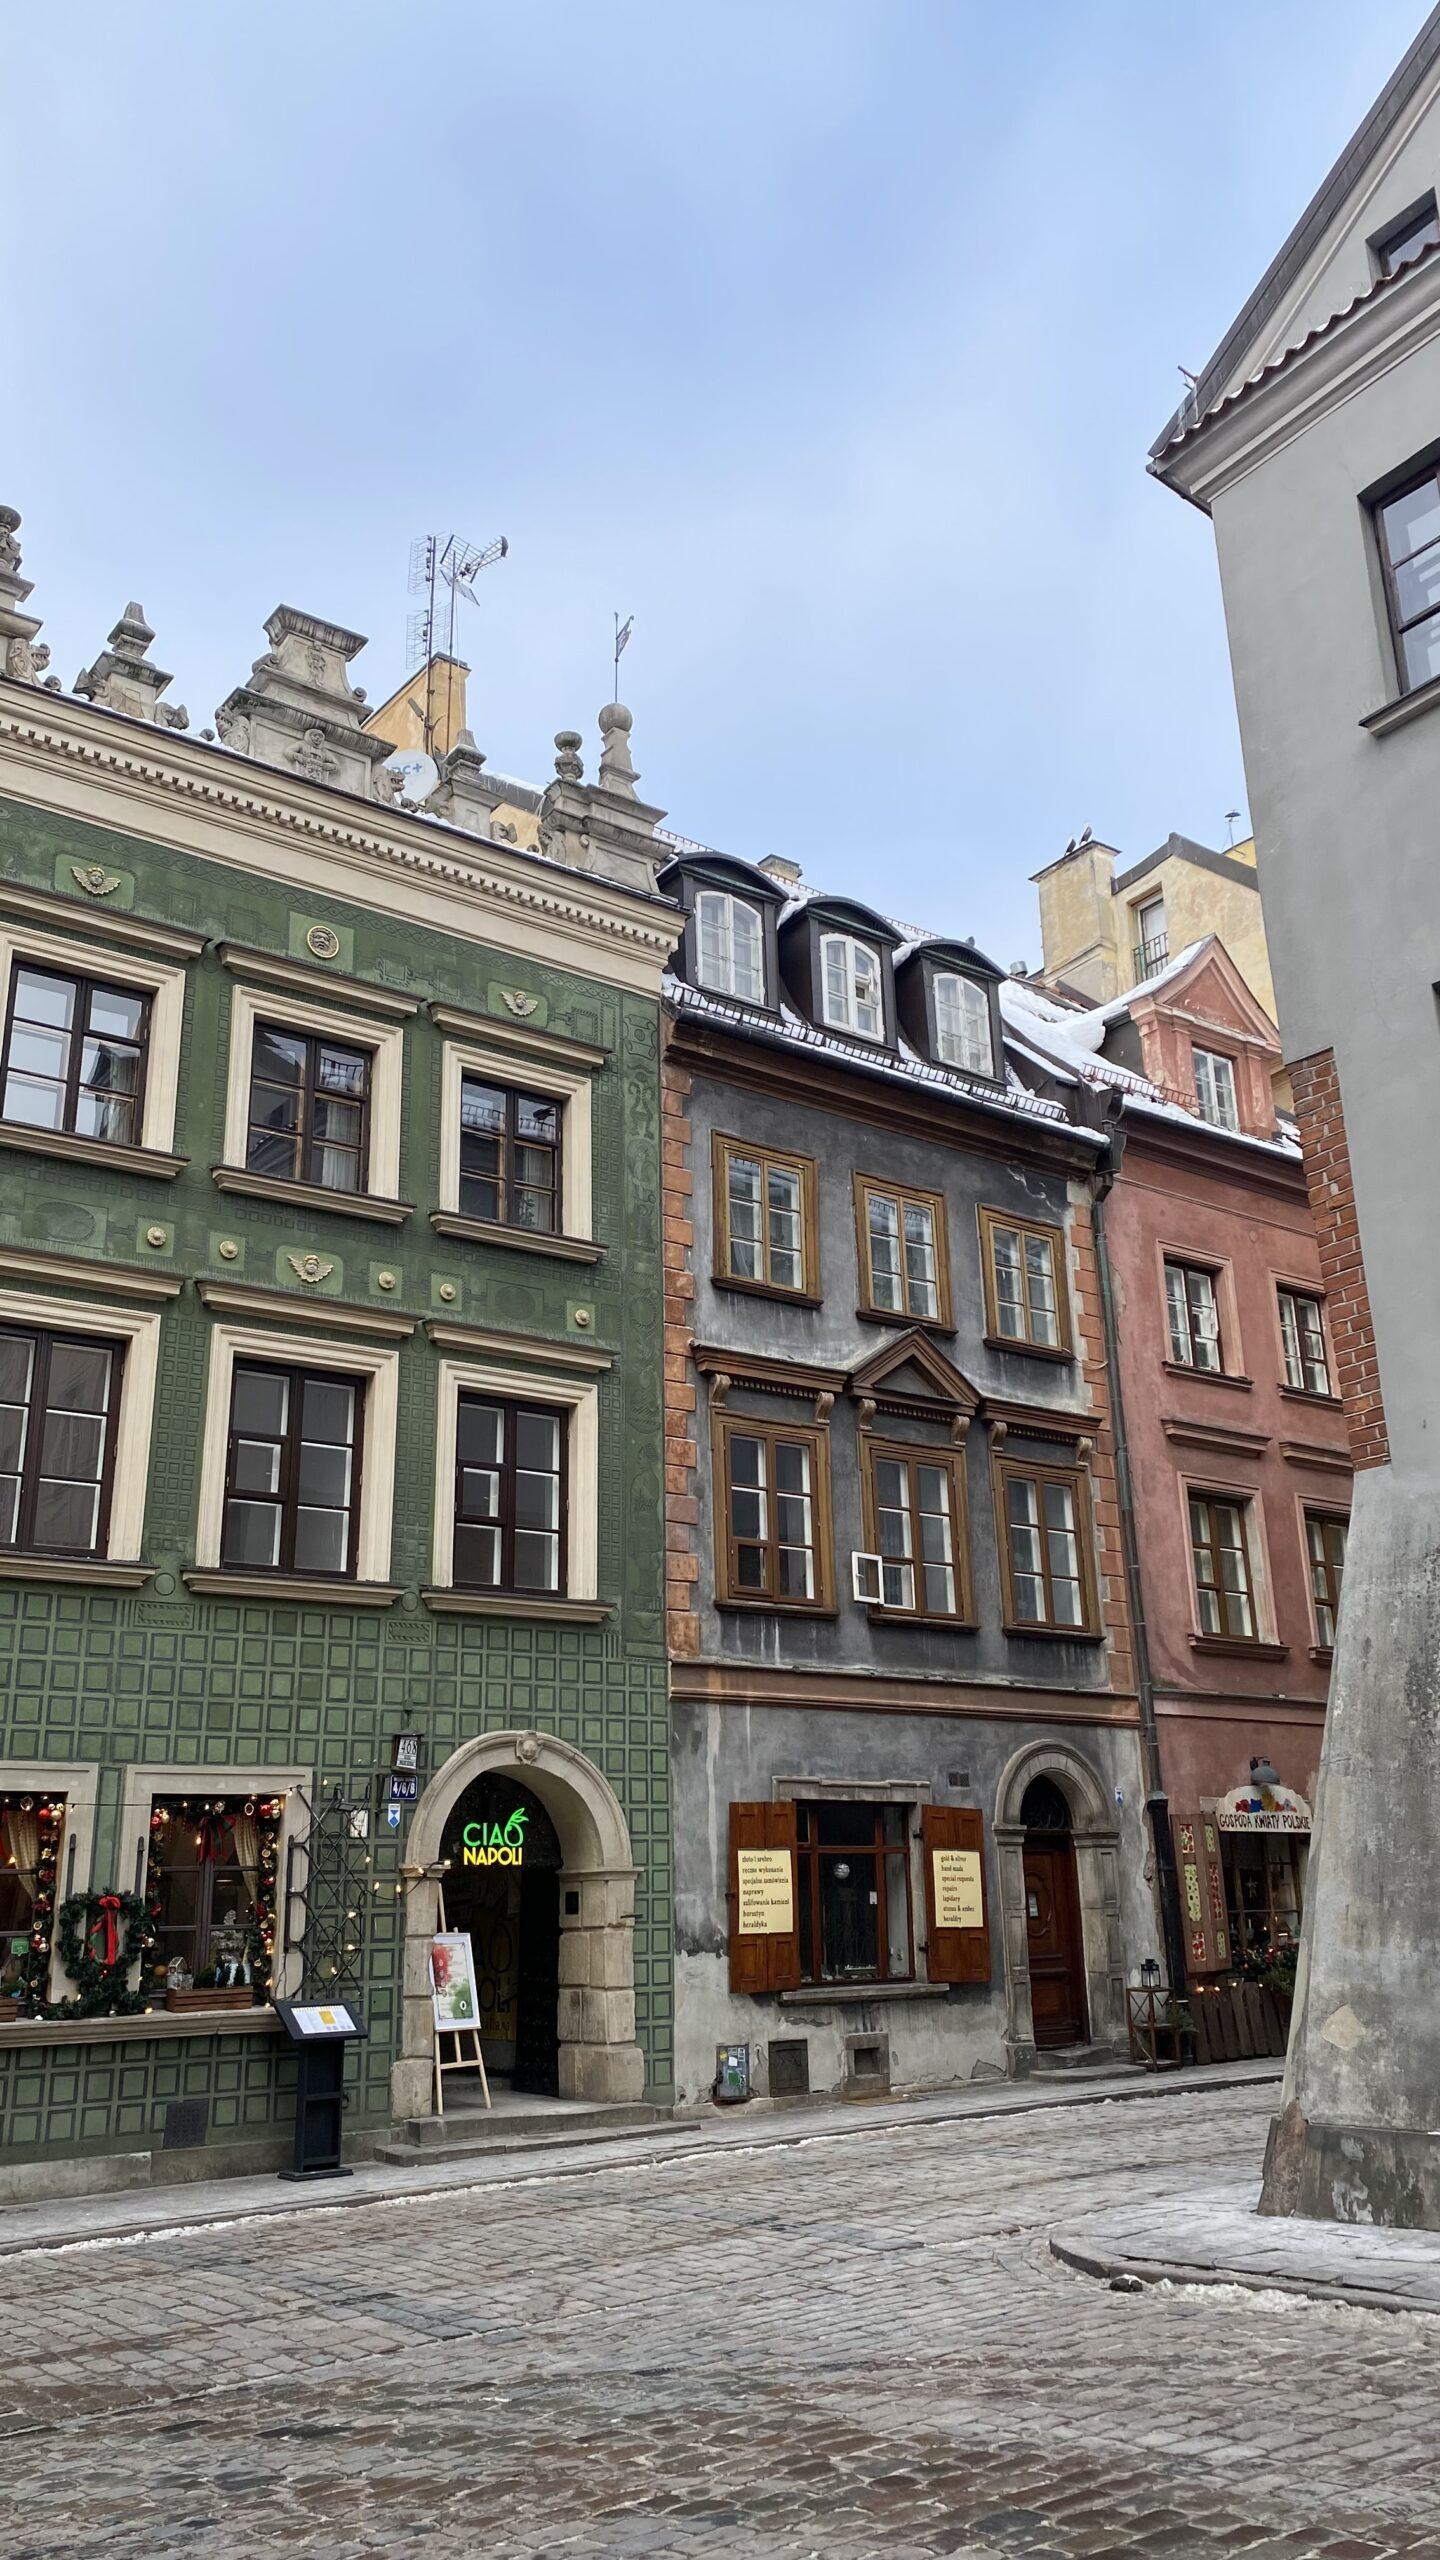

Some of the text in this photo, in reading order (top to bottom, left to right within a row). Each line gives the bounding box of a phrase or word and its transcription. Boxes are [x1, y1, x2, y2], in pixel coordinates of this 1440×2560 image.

[393, 1781, 416, 1797] 4/6/8
[1220, 1813, 1311, 1830] GOSPODA KWIATY POLSKIE
[463, 1846, 523, 1866] NAPOLI
[743, 1921, 767, 1929] heraldyka
